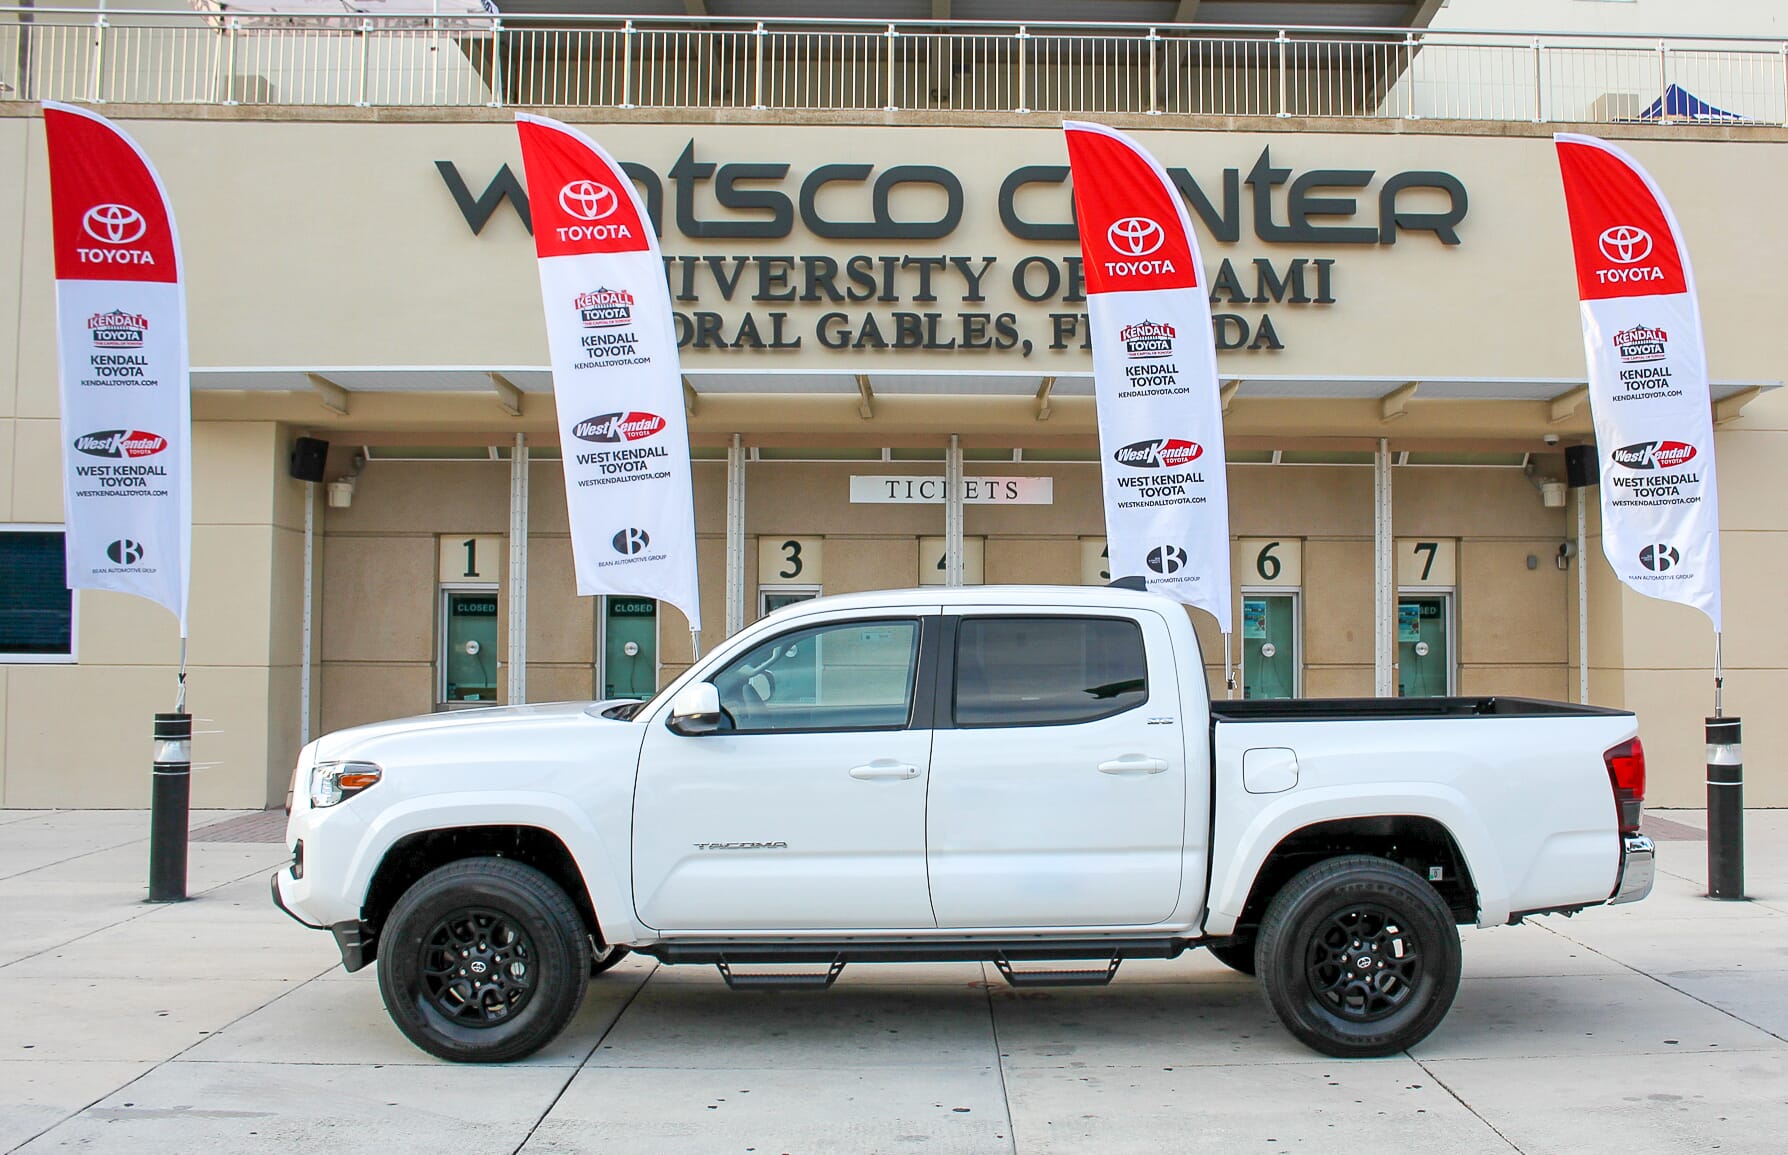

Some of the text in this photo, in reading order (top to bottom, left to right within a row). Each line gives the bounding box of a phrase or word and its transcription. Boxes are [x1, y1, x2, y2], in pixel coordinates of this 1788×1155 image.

[556, 225, 631, 242] TOYOTA
[77, 248, 155, 265] TOYOTA
[1105, 260, 1175, 276] TOYOTA
[662, 254, 997, 302] IVERSITY
[1209, 257, 1337, 304] AMI
[1596, 266, 1664, 284] TOYOTA
[577, 292, 631, 309] KENDALL
[584, 308, 627, 320] TOYOTA
[90, 315, 145, 329] KENDALL
[96, 331, 140, 340] TOYOTA
[672, 311, 801, 348] ORAL
[816, 311, 1033, 358] GABLES,
[1122, 325, 1174, 340] KENDALL
[1615, 330, 1666, 345] KENDALL
[581, 333, 639, 347] KENDALL
[1129, 340, 1169, 352] TOYOTA
[586, 345, 635, 359] TOYOTA
[1622, 344, 1662, 356] TOYOTA
[90, 355, 148, 365] KENDALL
[574, 357, 651, 369] KENDALLTOYOTA.COM
[94, 366, 144, 377] TOYOTA
[1125, 364, 1179, 376] KENDALL
[1620, 366, 1672, 381] KENDALL
[1130, 375, 1176, 387] TOYOTA
[1624, 379, 1669, 391] TOYOTA
[1118, 387, 1190, 399] KENDALLTOYOTA.COM
[1612, 390, 1683, 402] KENDALLTOYOTA.COM
[576, 446, 668, 464] WEST KENDALL
[76, 466, 167, 476] WEST KENDALL
[600, 461, 647, 474] TOYOTA
[100, 477, 147, 487] TOYOTA
[578, 472, 671, 487] WESTKENDALLTOYOTA.COM
[1117, 472, 1204, 487] WEST KENDALL
[1613, 473, 1699, 487] WEST KENDALL
[885, 480, 1018, 500] TICETS
[1139, 485, 1185, 498] TOYOTA
[1633, 486, 1679, 498] TOYOTA
[1118, 497, 1206, 509] WESTKENDALLTOYOTA.COM
[1612, 497, 1701, 507] WESTKENDALLTOYOTA.COM
[462, 537, 480, 578] 1
[614, 556, 647, 565] AUTOMOTIVE
[779, 540, 803, 579] 3
[1257, 542, 1281, 580] 6
[1413, 542, 1438, 580] 7
[1149, 577, 1183, 585] AUTOMOTIVE
[457, 603, 496, 612] CLOSED
[615, 604, 653, 612] CLOSED
[693, 841, 787, 850] TACOMA
